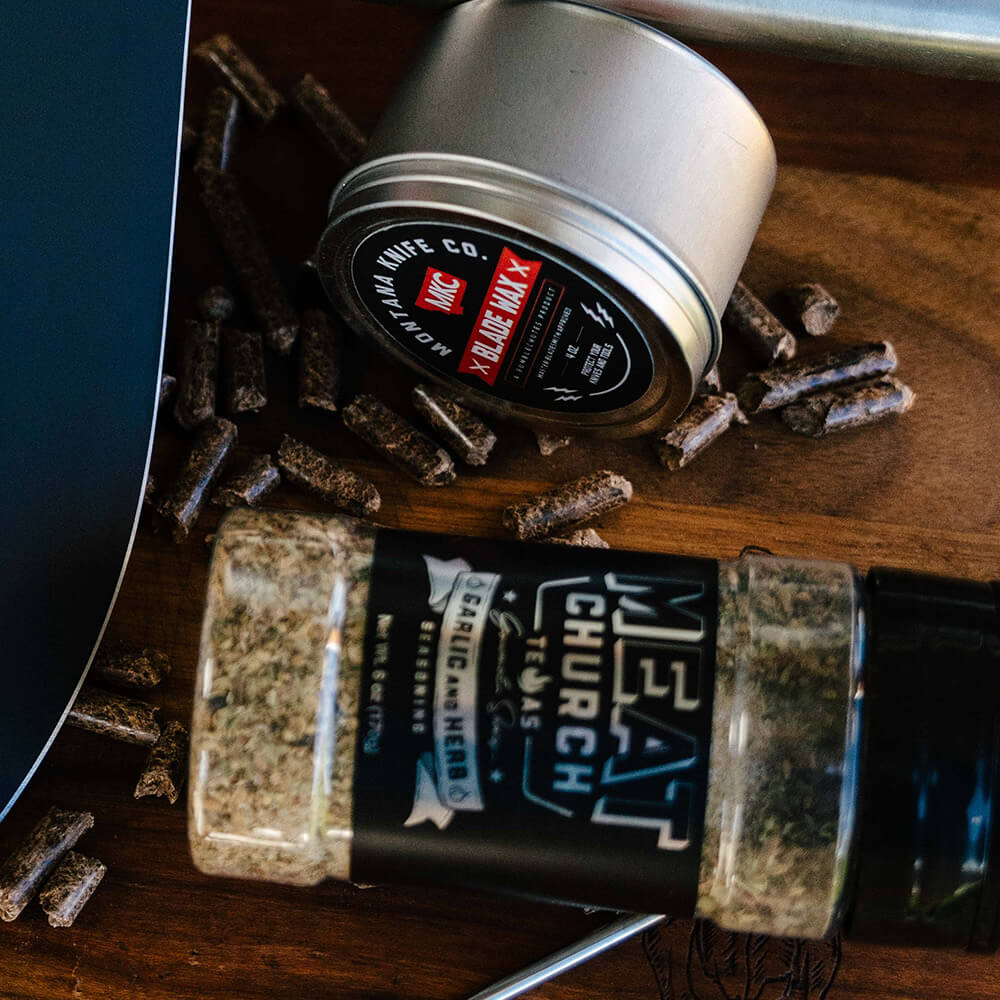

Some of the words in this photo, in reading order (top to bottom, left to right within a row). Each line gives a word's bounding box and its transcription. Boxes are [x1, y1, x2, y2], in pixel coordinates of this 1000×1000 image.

[376, 238, 435, 272] KNIFE
[441, 238, 488, 261] CO.
[424, 271, 461, 312] MKC
[488, 273, 529, 315] WAX
[537, 286, 557, 320] PRODUCT
[373, 274, 453, 357] MONTANA
[470, 309, 514, 363] BLADE
[580, 355, 596, 377] PROTECT
[589, 342, 602, 357] YOUR
[595, 357, 608, 369] AND
[599, 342, 614, 360] TOOLS
[589, 367, 603, 385] KNIVES
[446, 592, 481, 671] GARLIC
[411, 619, 436, 735] SEASONING
[445, 673, 460, 712] AND
[552, 591, 607, 794] CHURCH
[590, 572, 705, 851] MEAT
[443, 715, 468, 782] HERB
